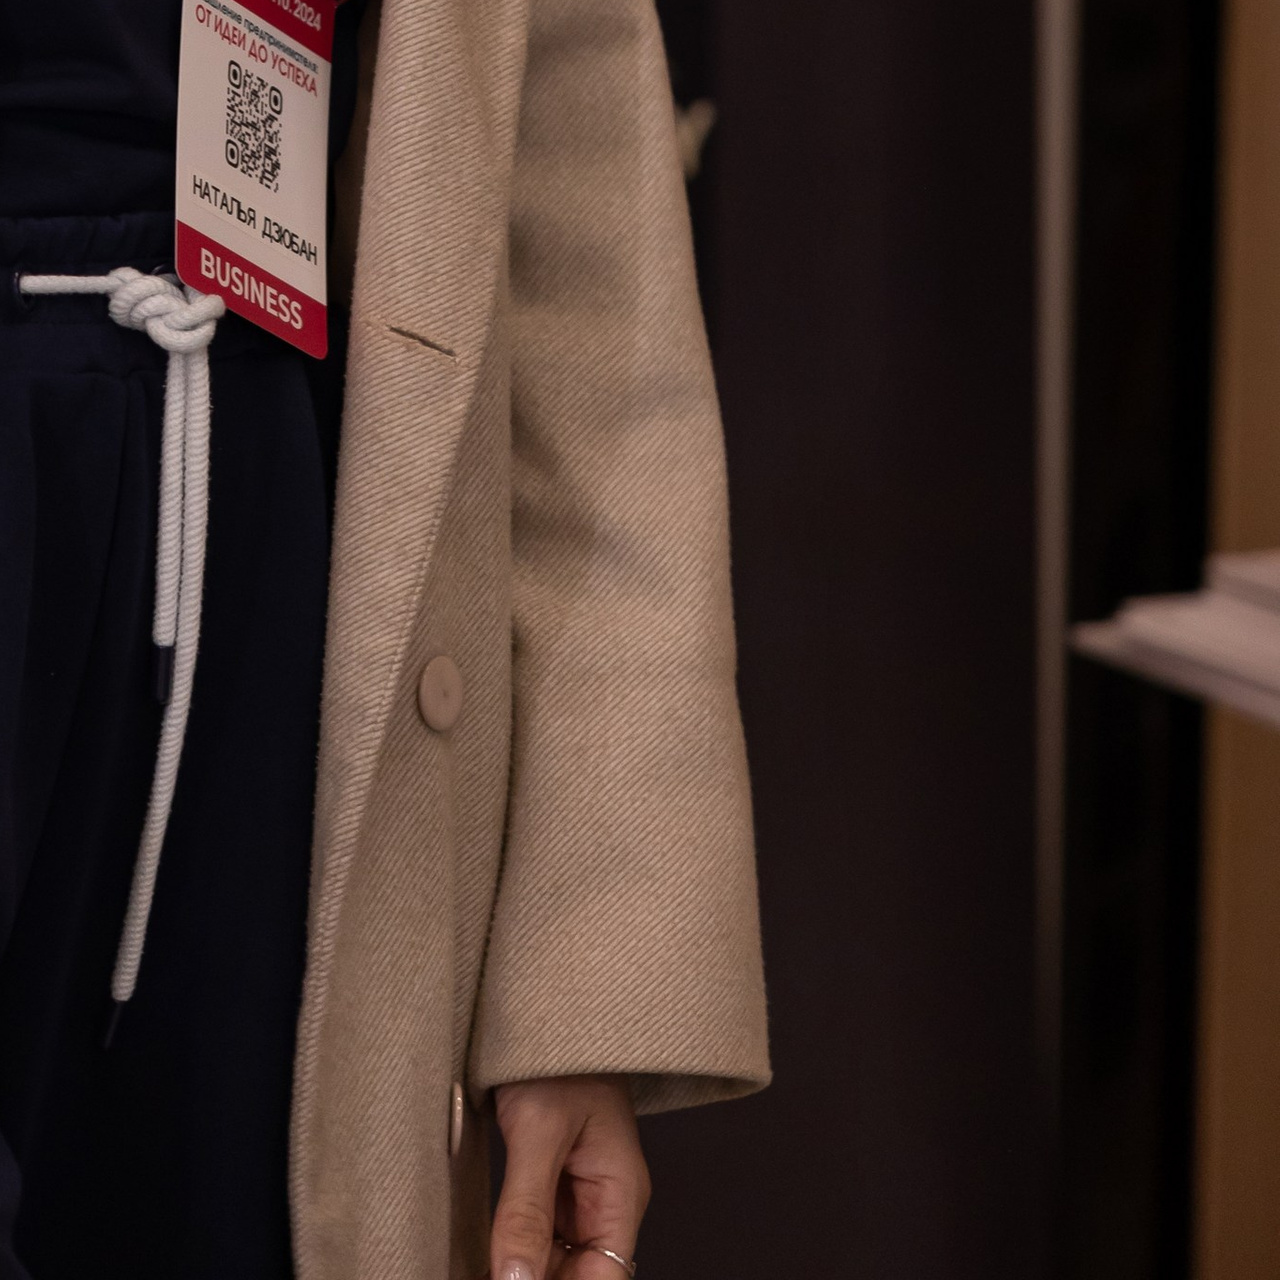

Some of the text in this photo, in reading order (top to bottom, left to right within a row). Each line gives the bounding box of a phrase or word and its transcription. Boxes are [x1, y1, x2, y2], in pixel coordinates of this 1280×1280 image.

[195, 3, 318, 98] ОТ ИДЕИ ДО УСПЕХА
[192, 174, 318, 266] НАТАЛЬЯ ДЗЮБАН
[200, 247, 304, 330] BUSINESS
